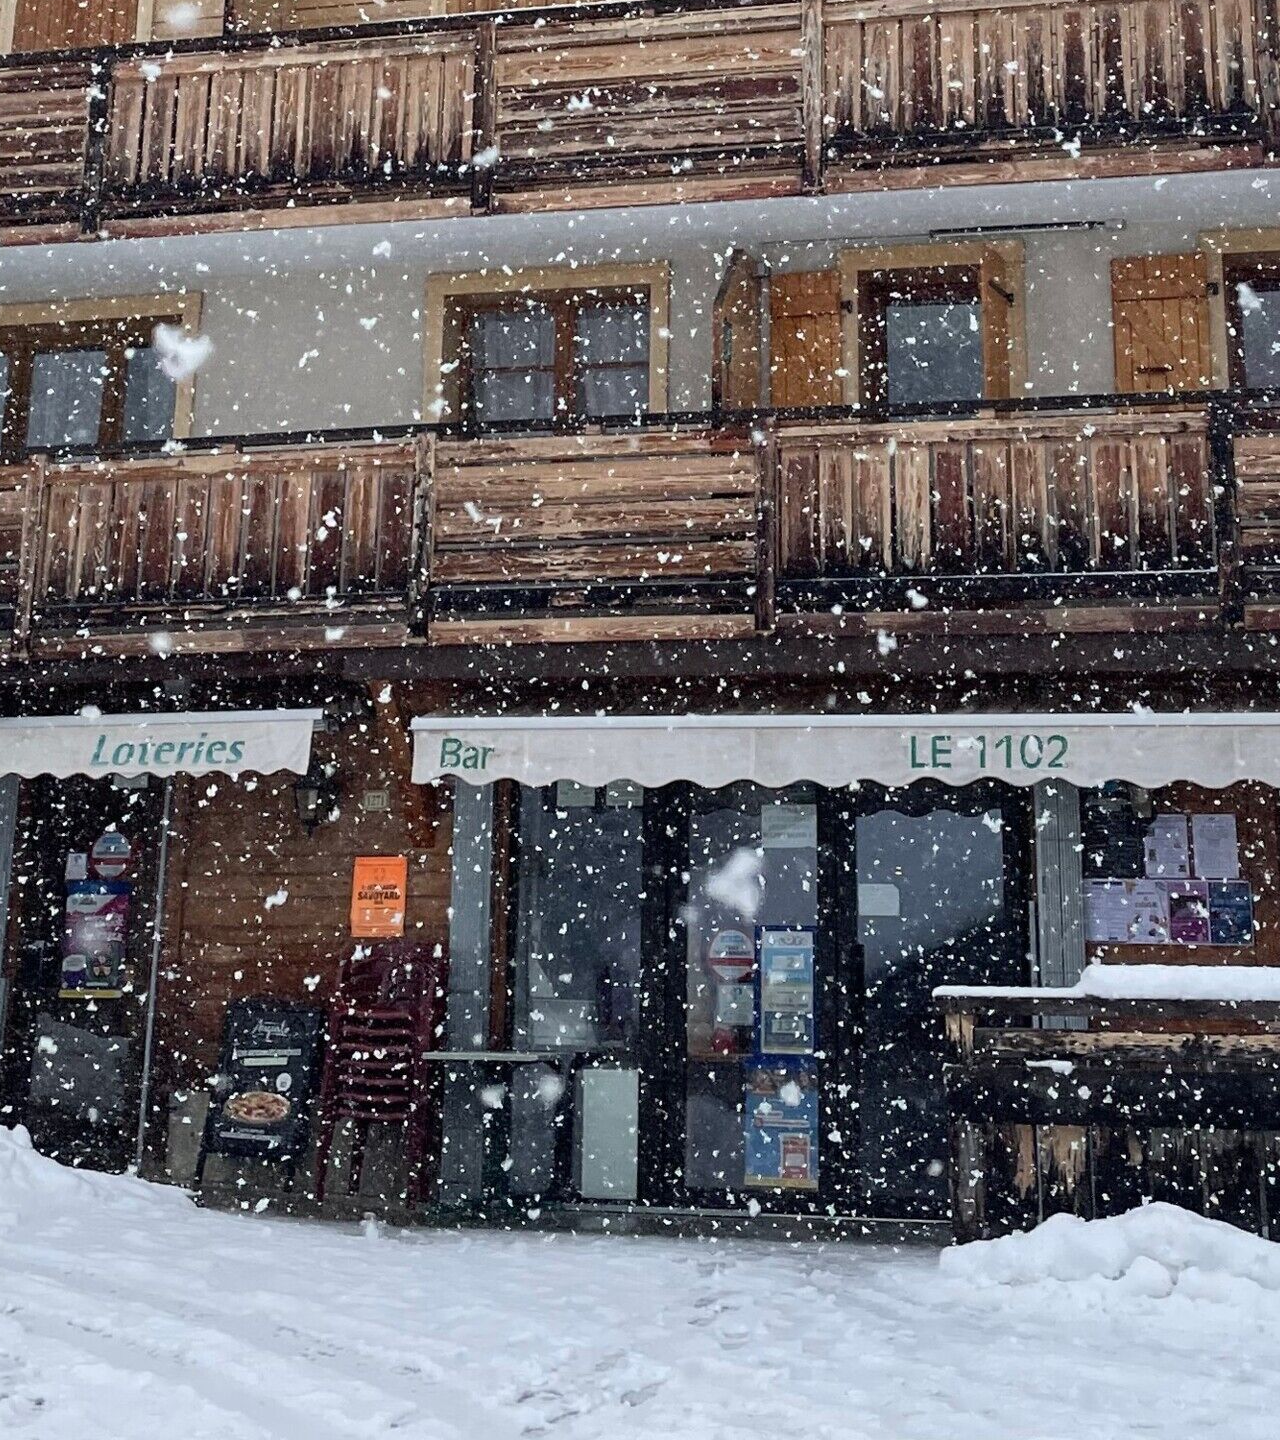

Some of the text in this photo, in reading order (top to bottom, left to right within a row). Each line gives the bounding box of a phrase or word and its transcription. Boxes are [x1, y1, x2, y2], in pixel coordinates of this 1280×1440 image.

[91, 732, 245, 766] Loteries
[440, 738, 495, 770] Bar
[910, 734, 1069, 768] LE 1102
